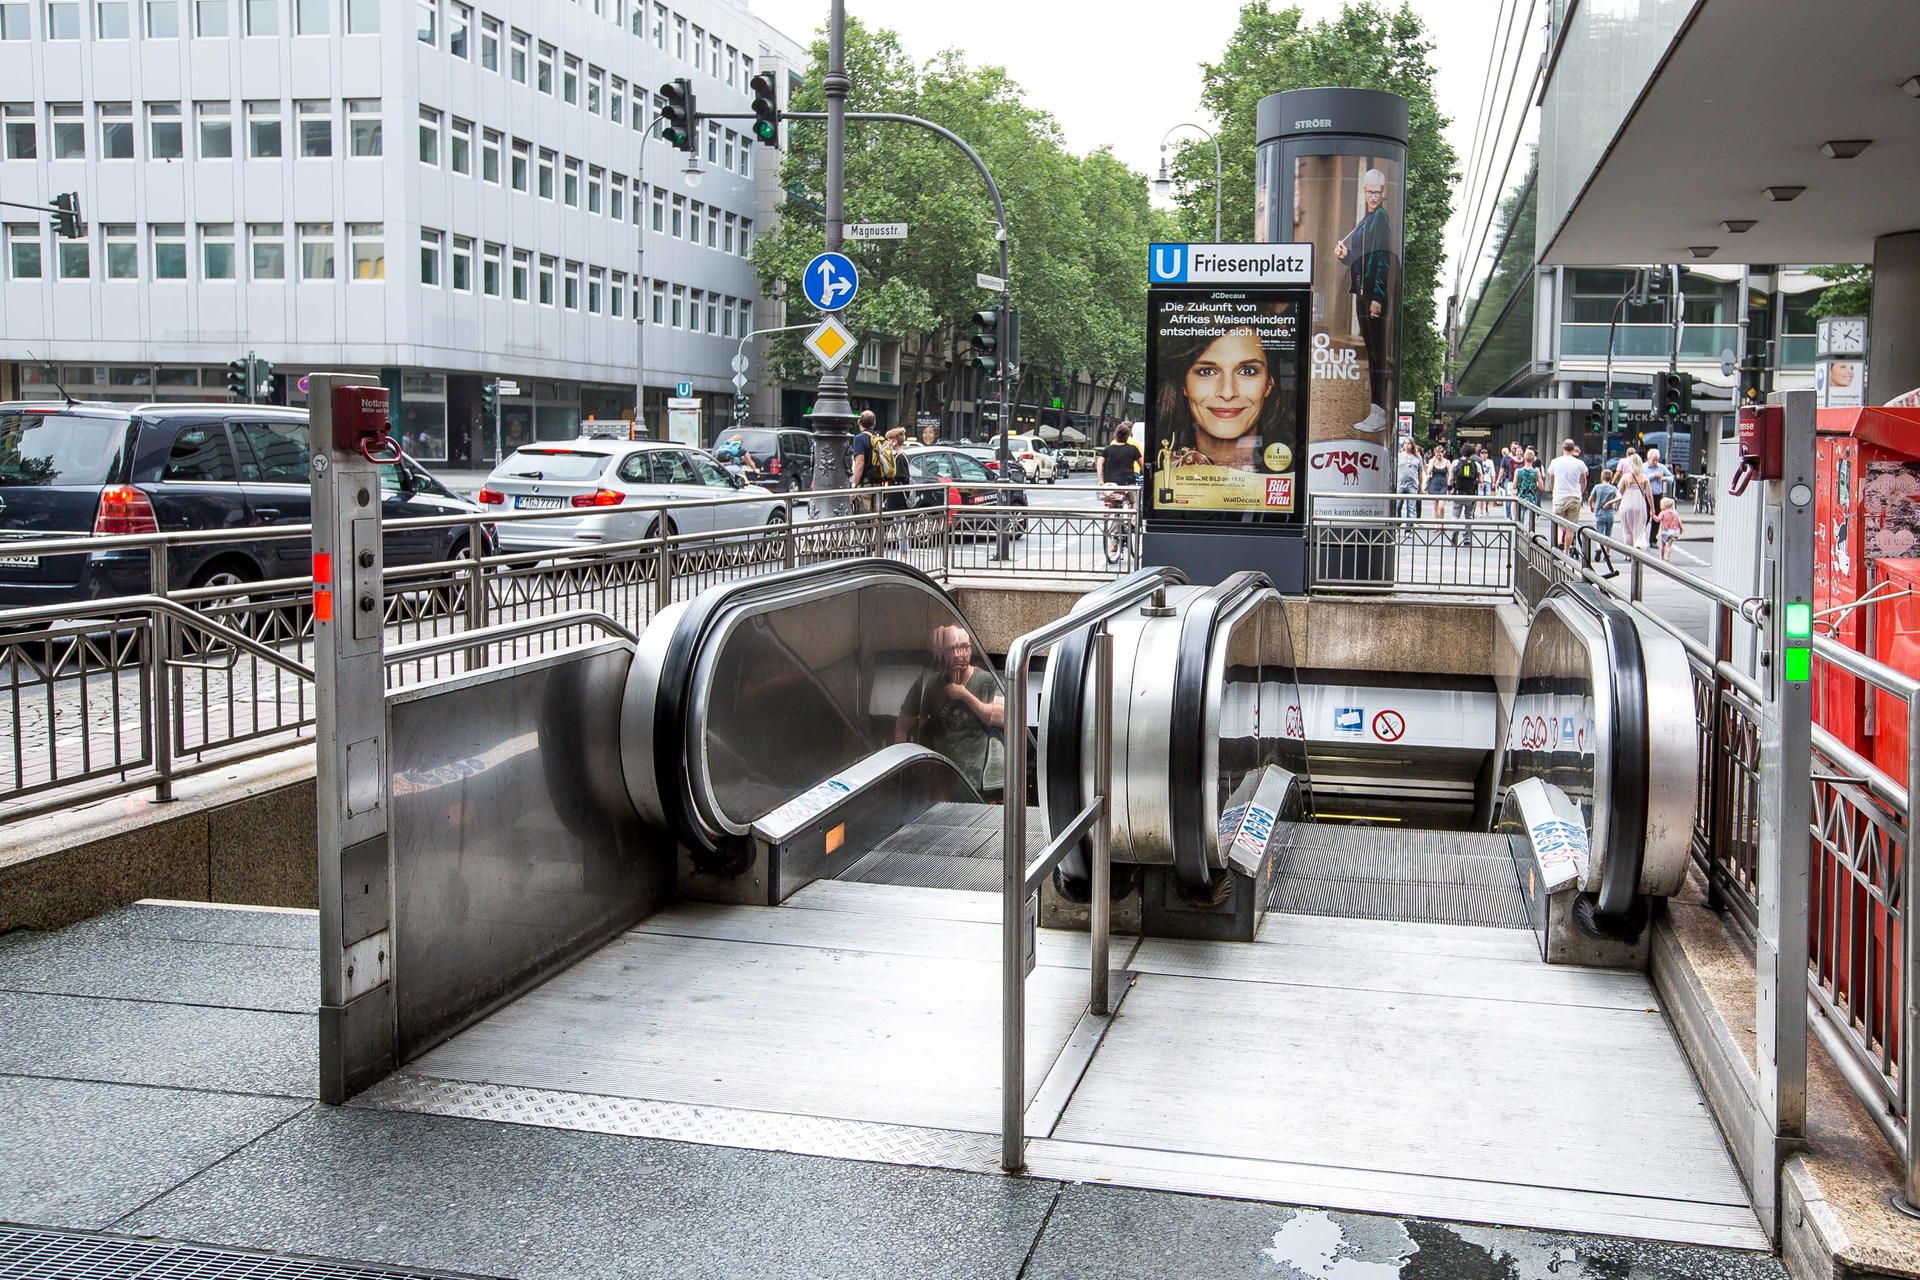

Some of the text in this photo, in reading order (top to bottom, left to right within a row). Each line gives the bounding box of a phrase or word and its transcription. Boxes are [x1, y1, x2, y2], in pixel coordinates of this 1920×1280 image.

[1295, 118, 1332, 129] STRÖER
[851, 226, 900, 238] Magnusstr.
[1156, 249, 1304, 279] U Friesenplatz
[1160, 302, 1257, 313] „Die Zukunft von
[1170, 314, 1296, 325] Afrikas Waisenkindern
[1160, 327, 1226, 337] entscheidet
[1229, 327, 1251, 337] sich
[1312, 332, 1330, 349] O
[1312, 348, 1357, 365] OUR
[1310, 450, 1380, 472] CAMEL
[1268, 479, 1290, 492] Bild
[1267, 492, 1290, 505] Frau
[1334, 508, 1351, 516] kann
[1352, 508, 1373, 516] tödlich
